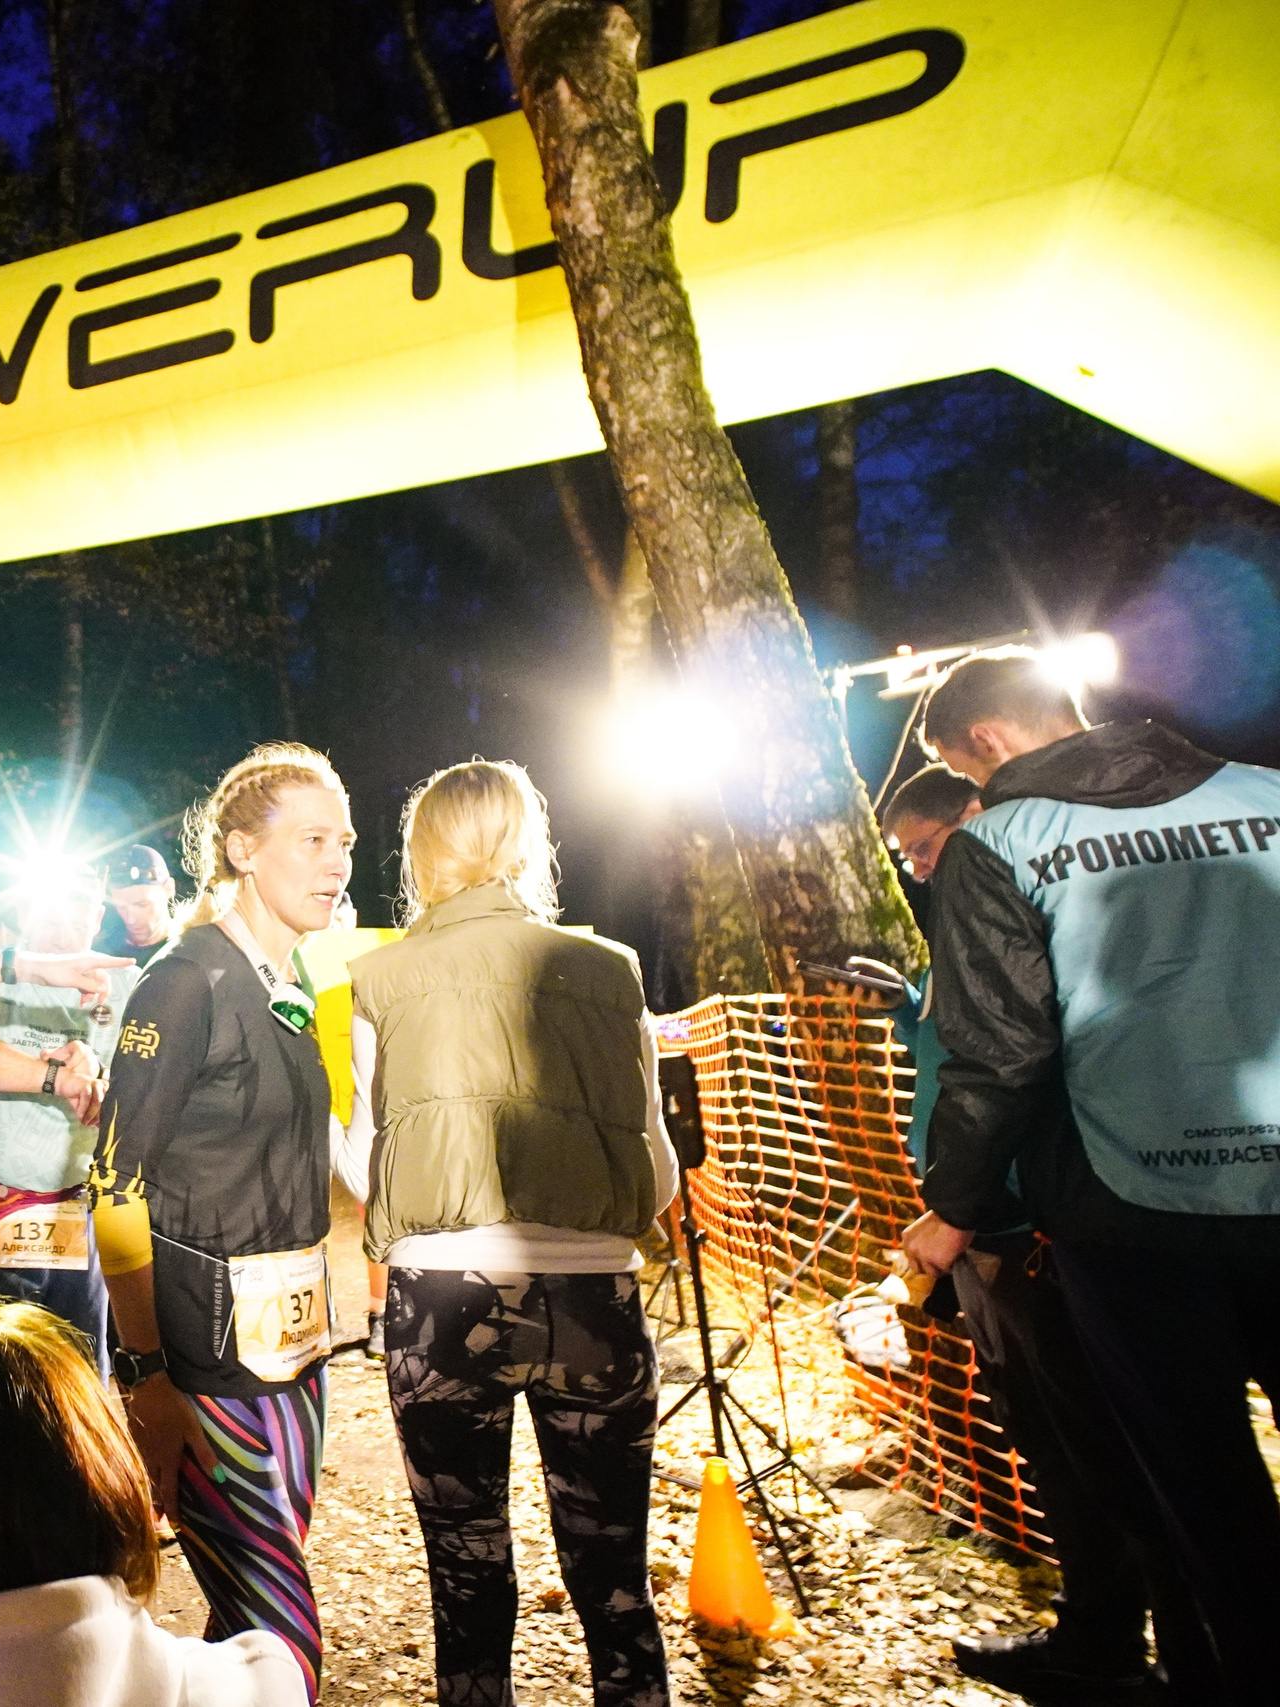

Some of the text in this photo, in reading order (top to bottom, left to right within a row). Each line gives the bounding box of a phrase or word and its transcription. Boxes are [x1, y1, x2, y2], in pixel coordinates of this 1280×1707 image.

[13, 1222, 57, 1240] 137
[2, 1243, 66, 1254] Александр
[290, 1289, 313, 1325] 37
